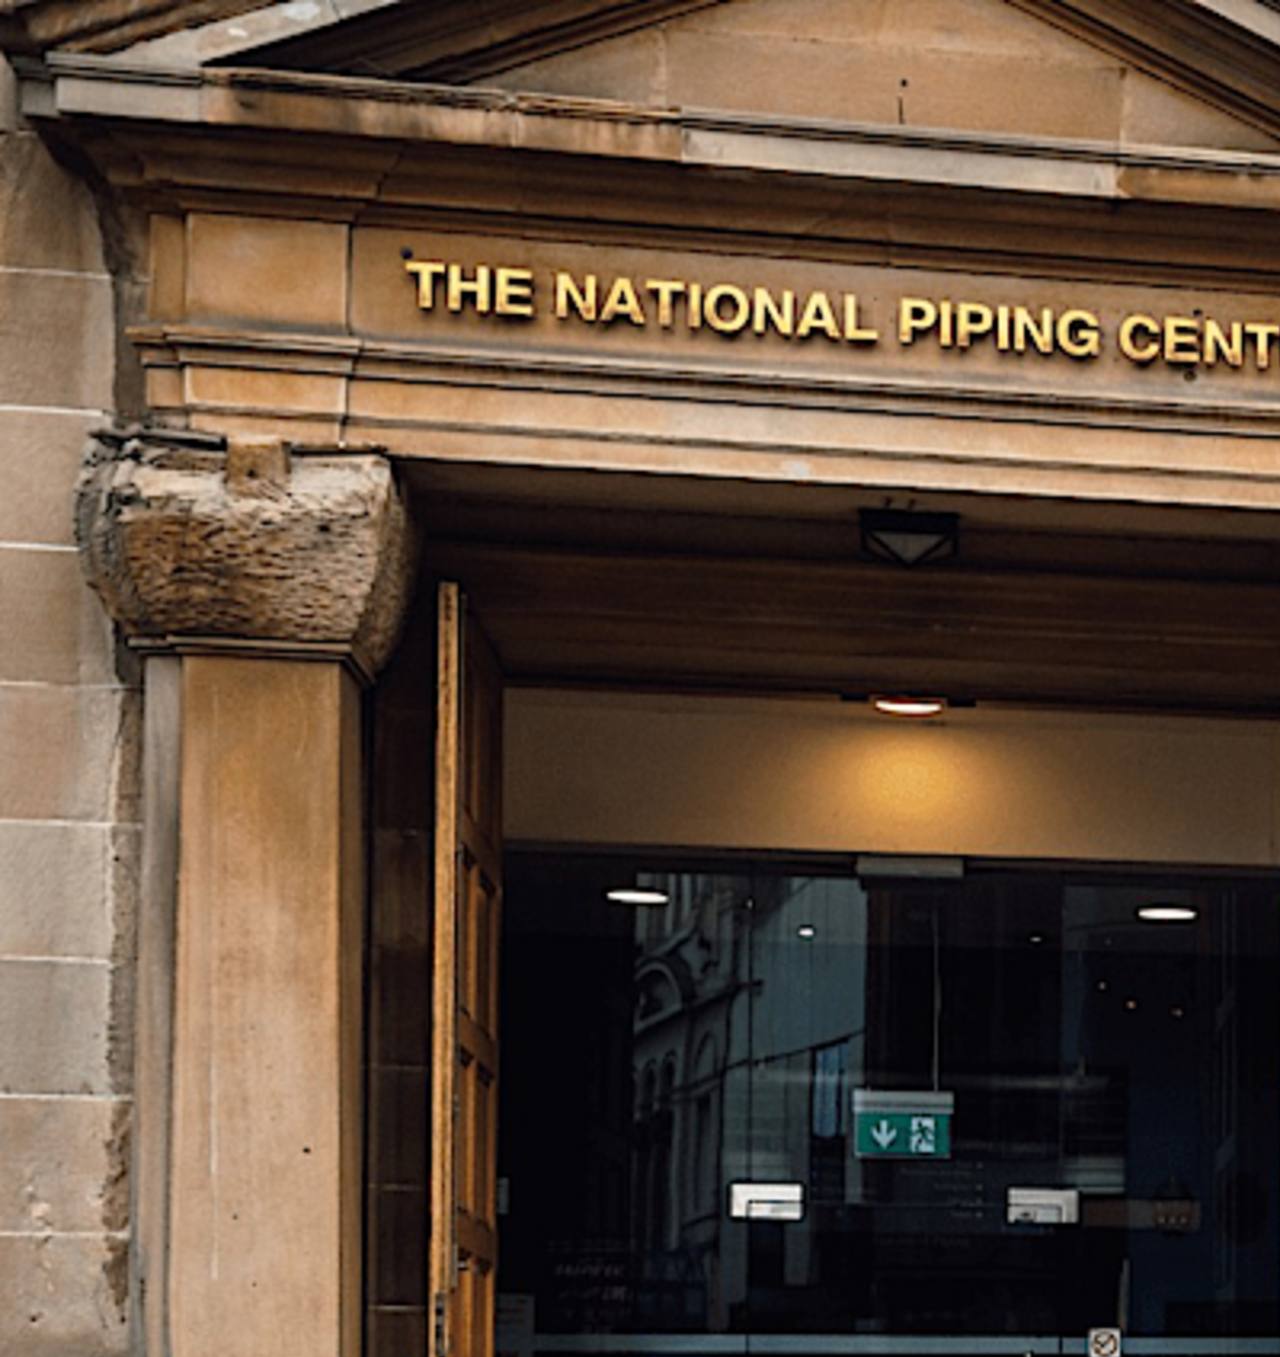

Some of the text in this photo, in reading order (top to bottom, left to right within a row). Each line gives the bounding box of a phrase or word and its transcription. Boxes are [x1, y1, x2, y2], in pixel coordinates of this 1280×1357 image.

[406, 261, 533, 317] THE
[556, 272, 879, 342] NATIONAL
[900, 299, 1099, 358] PIPING
